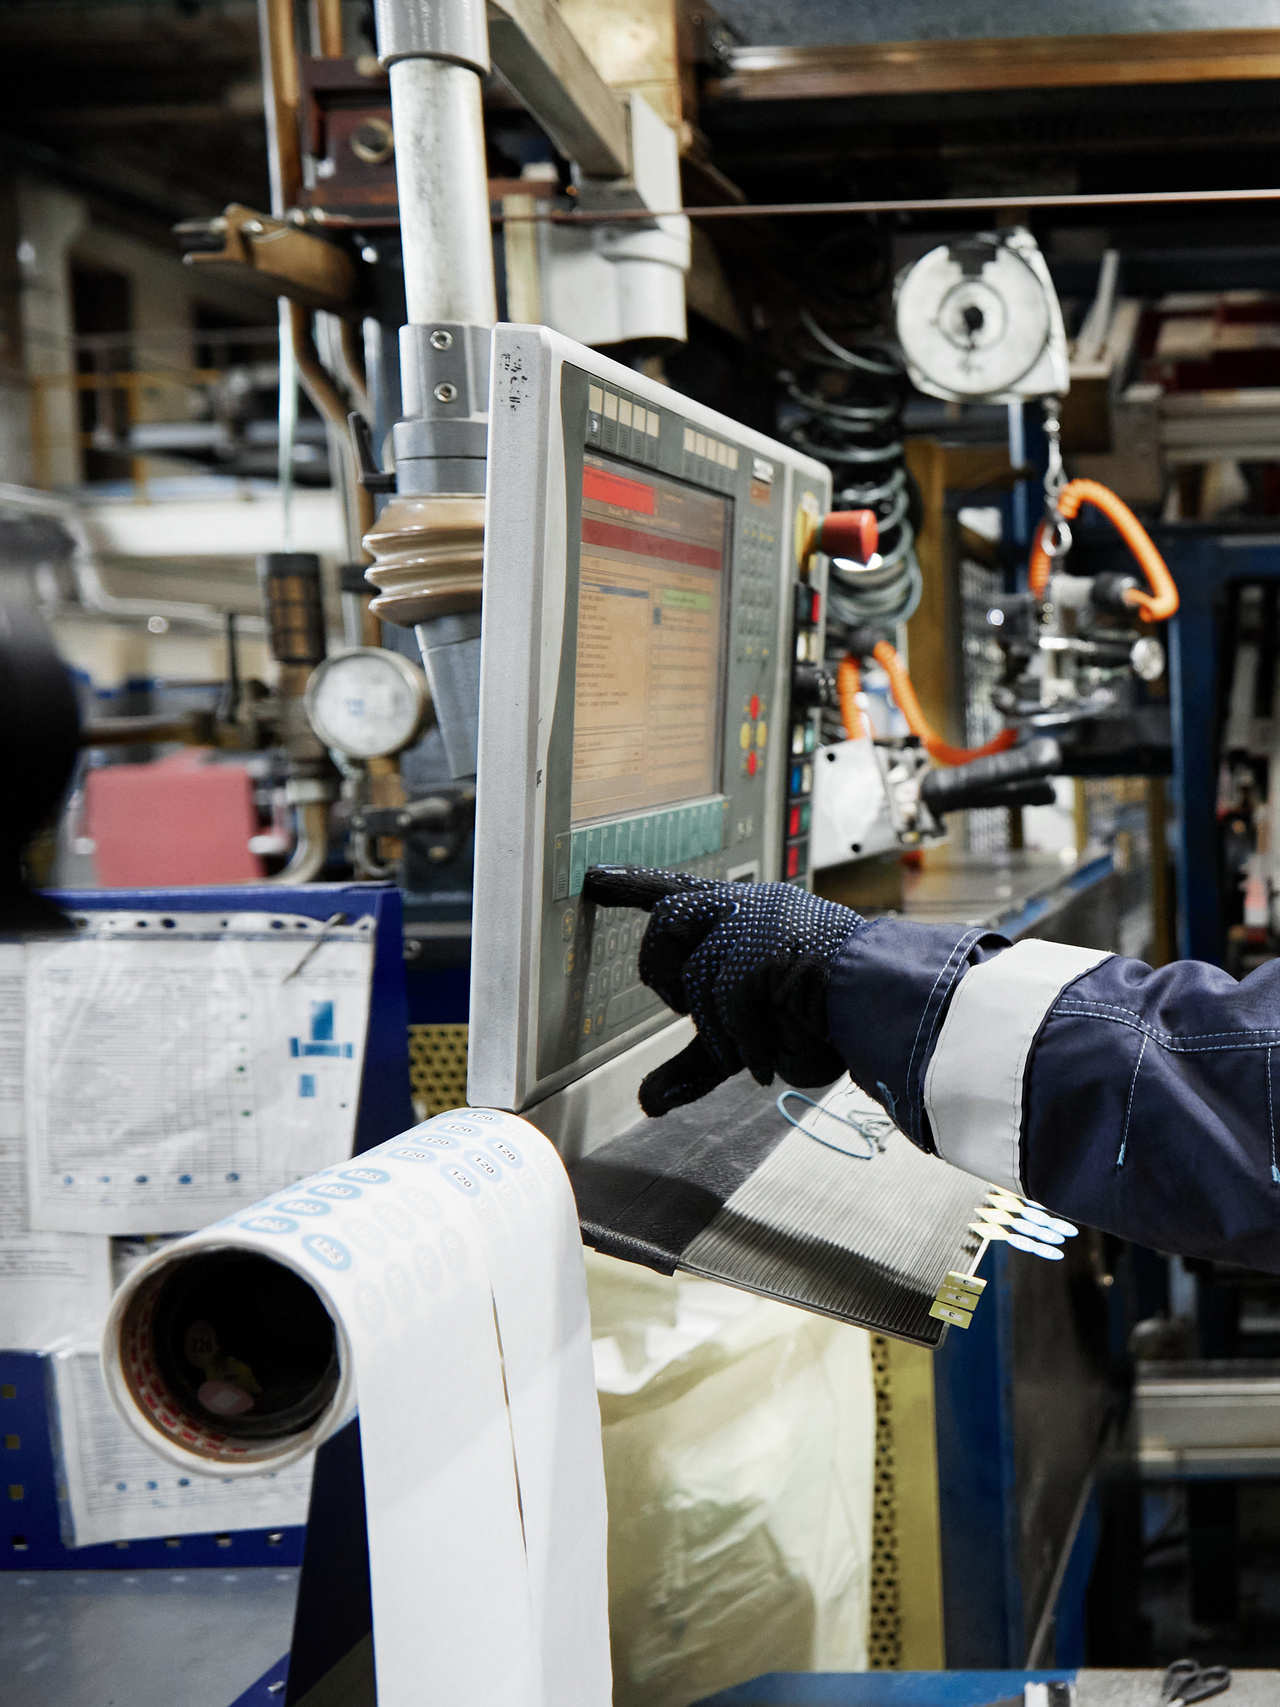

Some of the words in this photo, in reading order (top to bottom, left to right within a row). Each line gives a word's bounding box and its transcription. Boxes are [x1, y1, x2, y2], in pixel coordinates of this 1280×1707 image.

[470, 1112, 494, 1122] 120
[448, 1124, 473, 1134] 120
[425, 1136, 450, 1147] 120
[400, 1149, 426, 1160] 120
[497, 1143, 516, 1161] 120
[474, 1156, 495, 1174] 120
[354, 1170, 377, 1180] 125
[452, 1170, 473, 1189] 120
[324, 1185, 352, 1196] 125
[317, 1239, 341, 1261] 125
